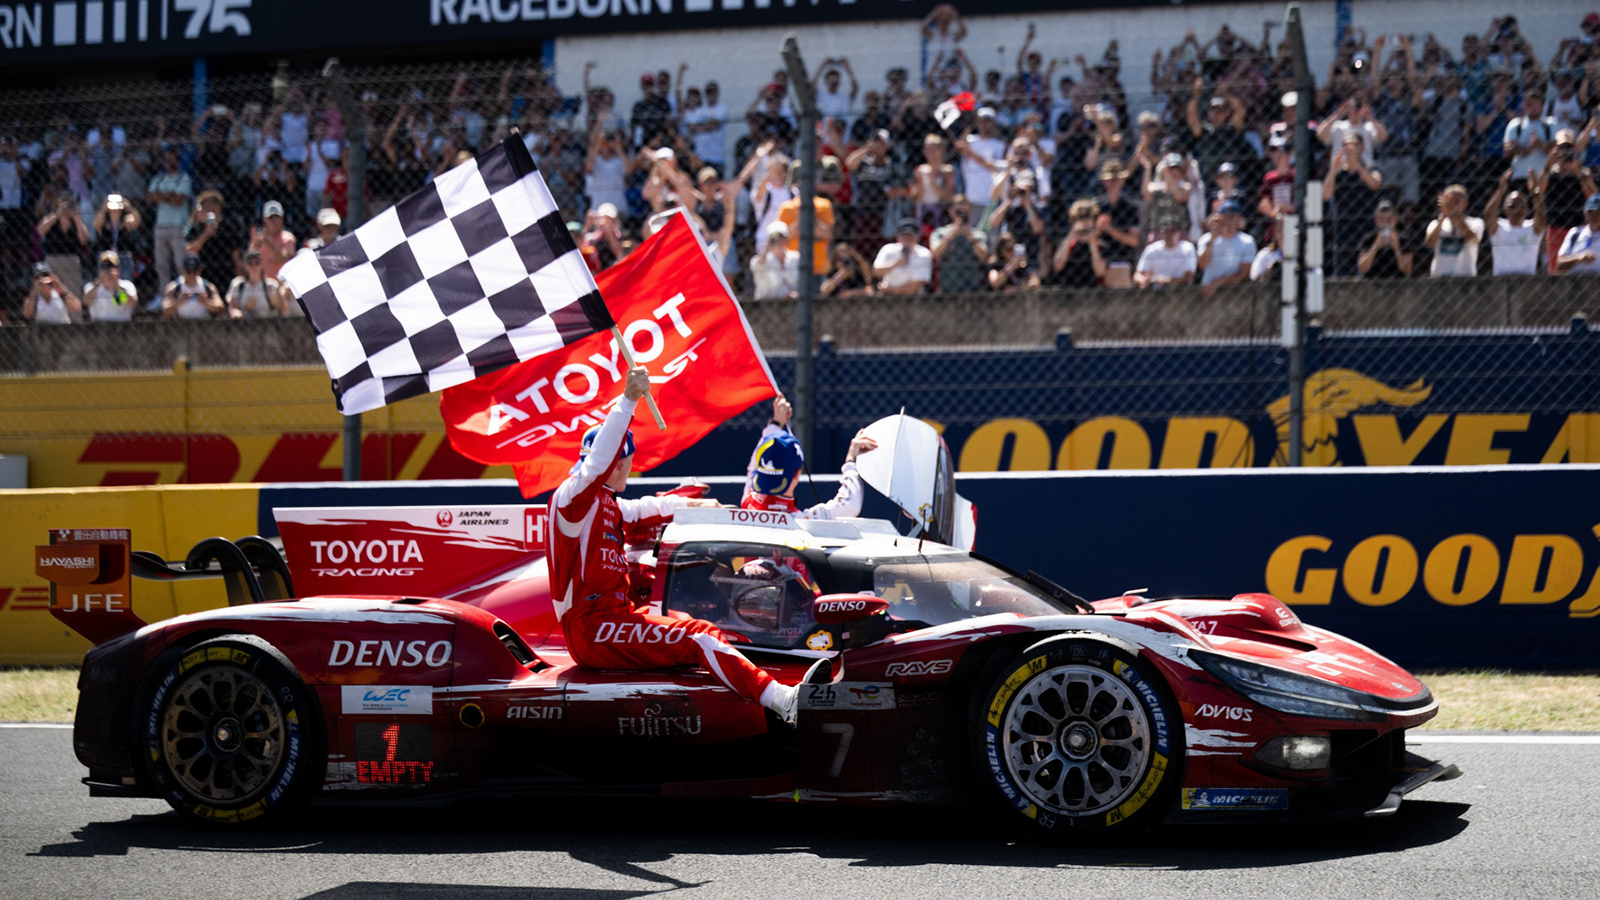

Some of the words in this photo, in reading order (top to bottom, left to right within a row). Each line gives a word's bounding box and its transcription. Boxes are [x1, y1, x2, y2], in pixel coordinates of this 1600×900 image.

[922, 416, 1256, 472] OOD
[526, 514, 549, 543] H
[729, 510, 788, 525] TOYOTA
[40, 555, 95, 567] HAYASHI
[310, 539, 424, 564] TOYOTA
[311, 567, 424, 577] RACING
[1265, 533, 1584, 607] GOOD
[62, 594, 124, 612] JFE
[818, 600, 866, 613] DENSO
[594, 621, 687, 645] DENSO
[328, 640, 453, 667] DENSO
[885, 659, 953, 677] RAYS
[362, 689, 411, 701] WEC
[507, 706, 562, 720] AISIN
[1134, 680, 1168, 748] MICHELIN
[1194, 703, 1253, 722] ADVICS
[618, 710, 702, 740] FUJITSU
[382, 723, 400, 761] 1
[819, 722, 855, 778] 7
[356, 760, 434, 783] EMPTY
[986, 731, 1017, 800] MICHELIN
